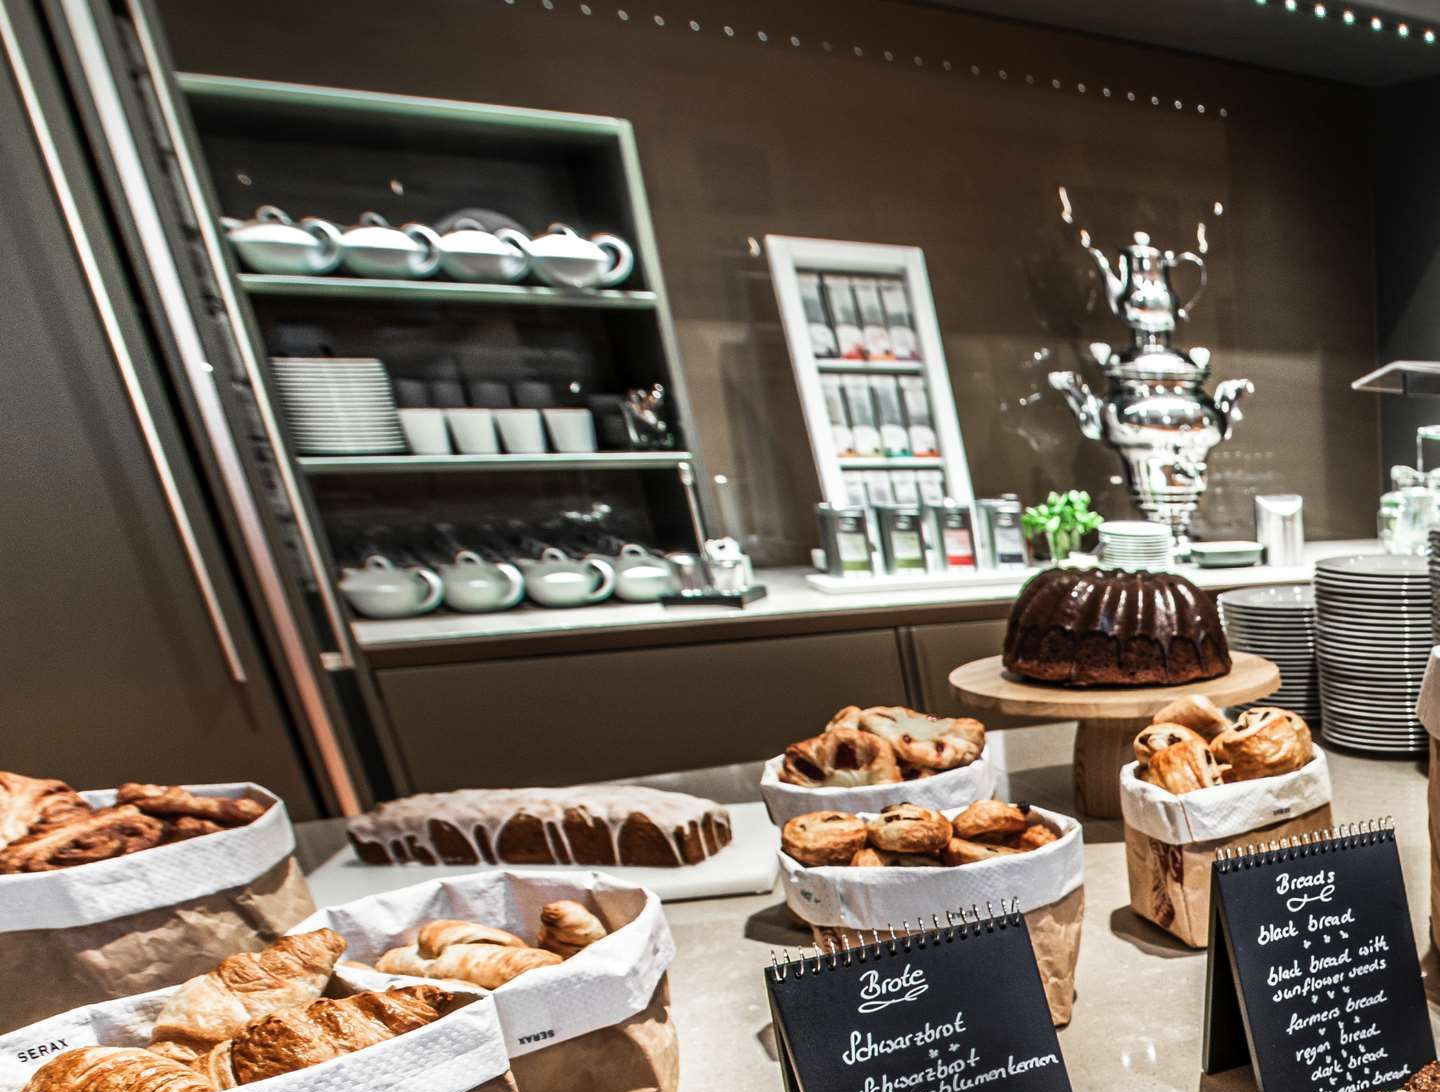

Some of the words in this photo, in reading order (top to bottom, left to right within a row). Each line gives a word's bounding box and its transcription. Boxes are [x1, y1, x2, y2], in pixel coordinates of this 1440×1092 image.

[1276, 870, 1335, 894] Breads
[1257, 920, 1299, 945] black
[1308, 908, 1355, 932] bread
[1267, 960, 1302, 986] black
[1309, 948, 1352, 973] bread
[1359, 935, 1389, 956] with
[860, 963, 926, 999] Brote
[1273, 972, 1344, 1002] sunflower
[1348, 959, 1386, 978] seeds
[1286, 1007, 1340, 1035] farmers
[1345, 990, 1387, 1012] bread
[17, 1038, 69, 1063] SERAX
[517, 1029, 555, 1045] SERAX
[842, 1011, 966, 1065] Schwarzbrot
[1296, 1041, 1330, 1065] vegan
[1340, 1023, 1381, 1045] bread
[1311, 1060, 1343, 1081] dark
[1348, 1047, 1388, 1069] bread
[1372, 1064, 1411, 1085] bread
